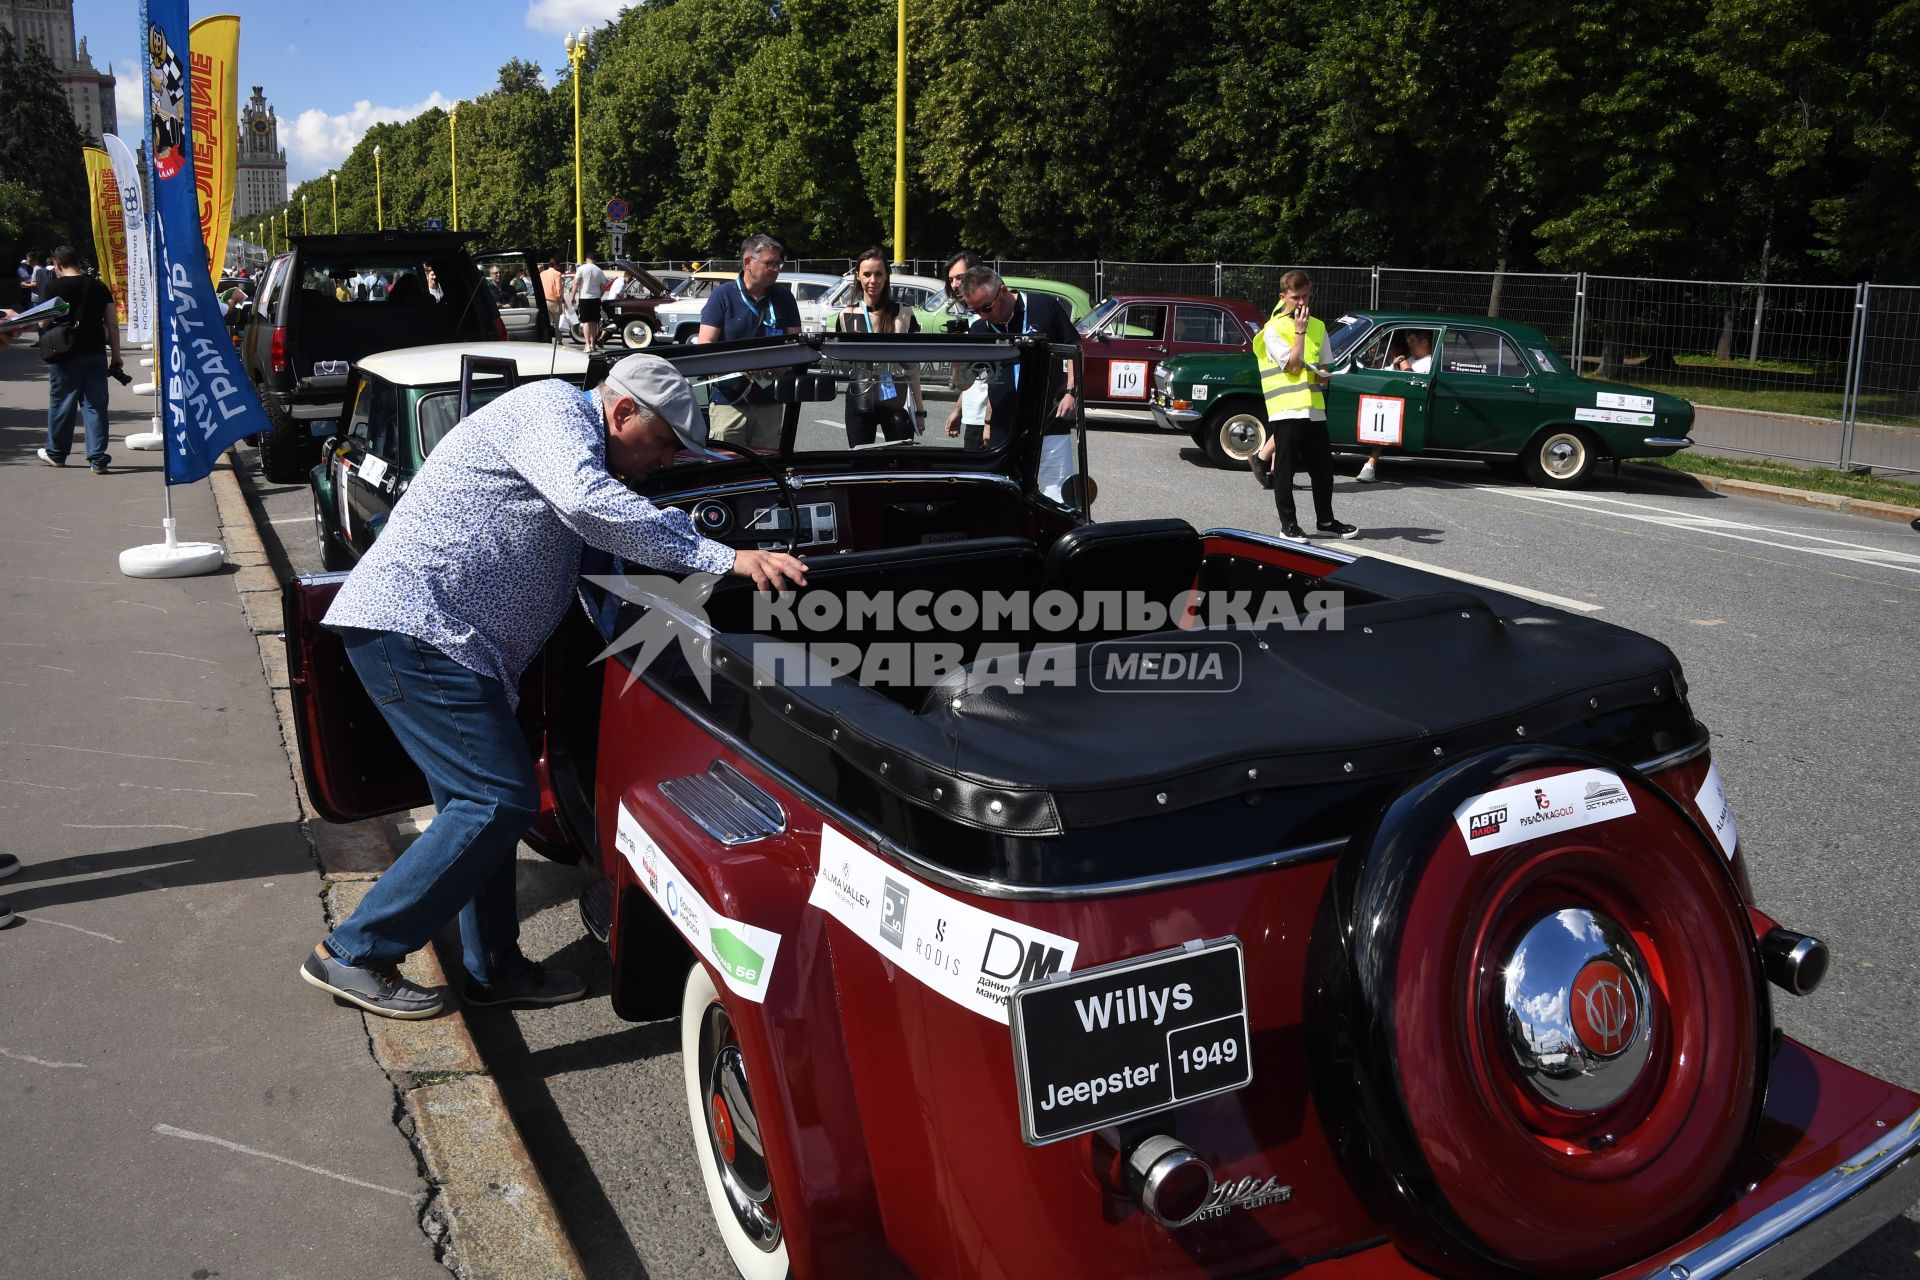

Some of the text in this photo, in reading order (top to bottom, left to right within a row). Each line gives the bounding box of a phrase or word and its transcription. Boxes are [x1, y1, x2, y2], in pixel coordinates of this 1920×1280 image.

[171, 262, 247, 421] ГРАН ТУР
[169, 316, 186, 456] КУБОК
[1117, 372, 1137, 389] 119
[1373, 412, 1385, 432] 11
[1586, 796, 1629, 811] ОСТАНКИНО
[1471, 824, 1498, 838] ПЛЮС
[1472, 809, 1506, 830] АВТО
[916, 937, 961, 976] RODIS
[980, 928, 1064, 984] DM
[736, 965, 757, 981] 56
[1074, 982, 1194, 1033] Willys
[1178, 1038, 1238, 1074] 1949
[1040, 1062, 1160, 1111] Jeepster
[1243, 1190, 1291, 1210] CENTER
